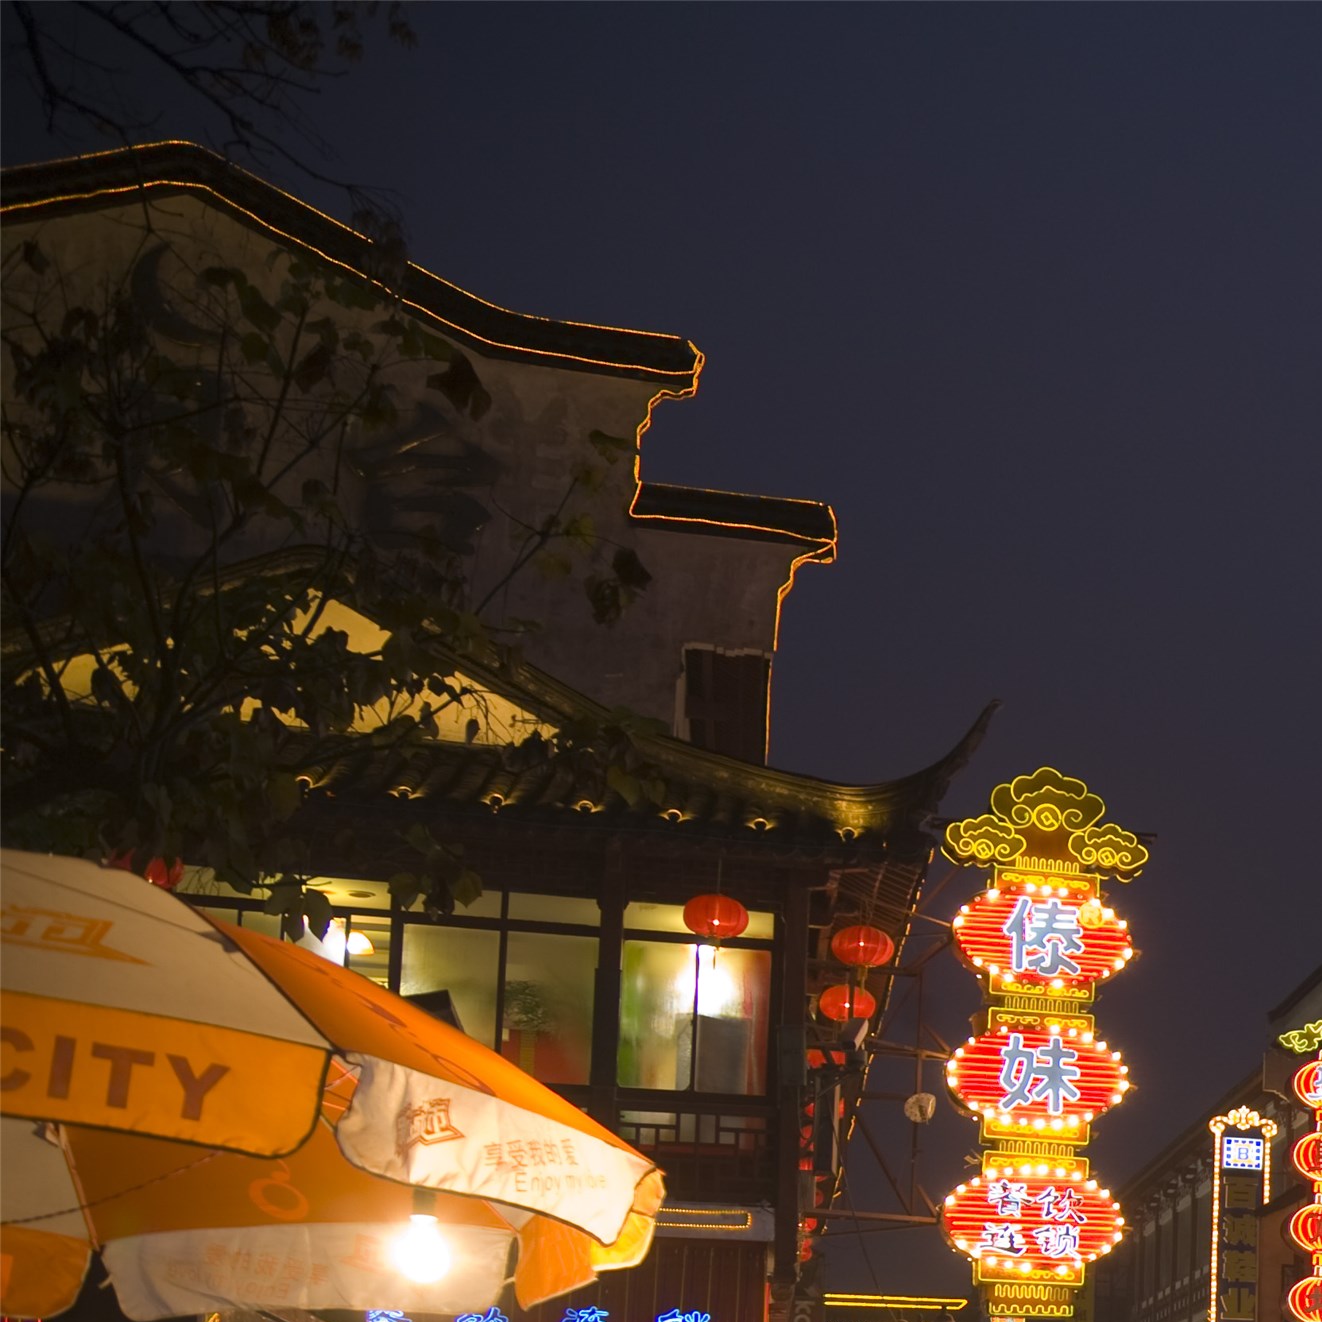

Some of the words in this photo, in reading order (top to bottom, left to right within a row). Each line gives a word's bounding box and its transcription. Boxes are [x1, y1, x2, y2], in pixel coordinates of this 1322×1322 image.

[1001, 896, 1083, 1115] 傣妹
[484, 1138, 579, 1168] 享受我的爱
[515, 1171, 562, 1198] Enjoy
